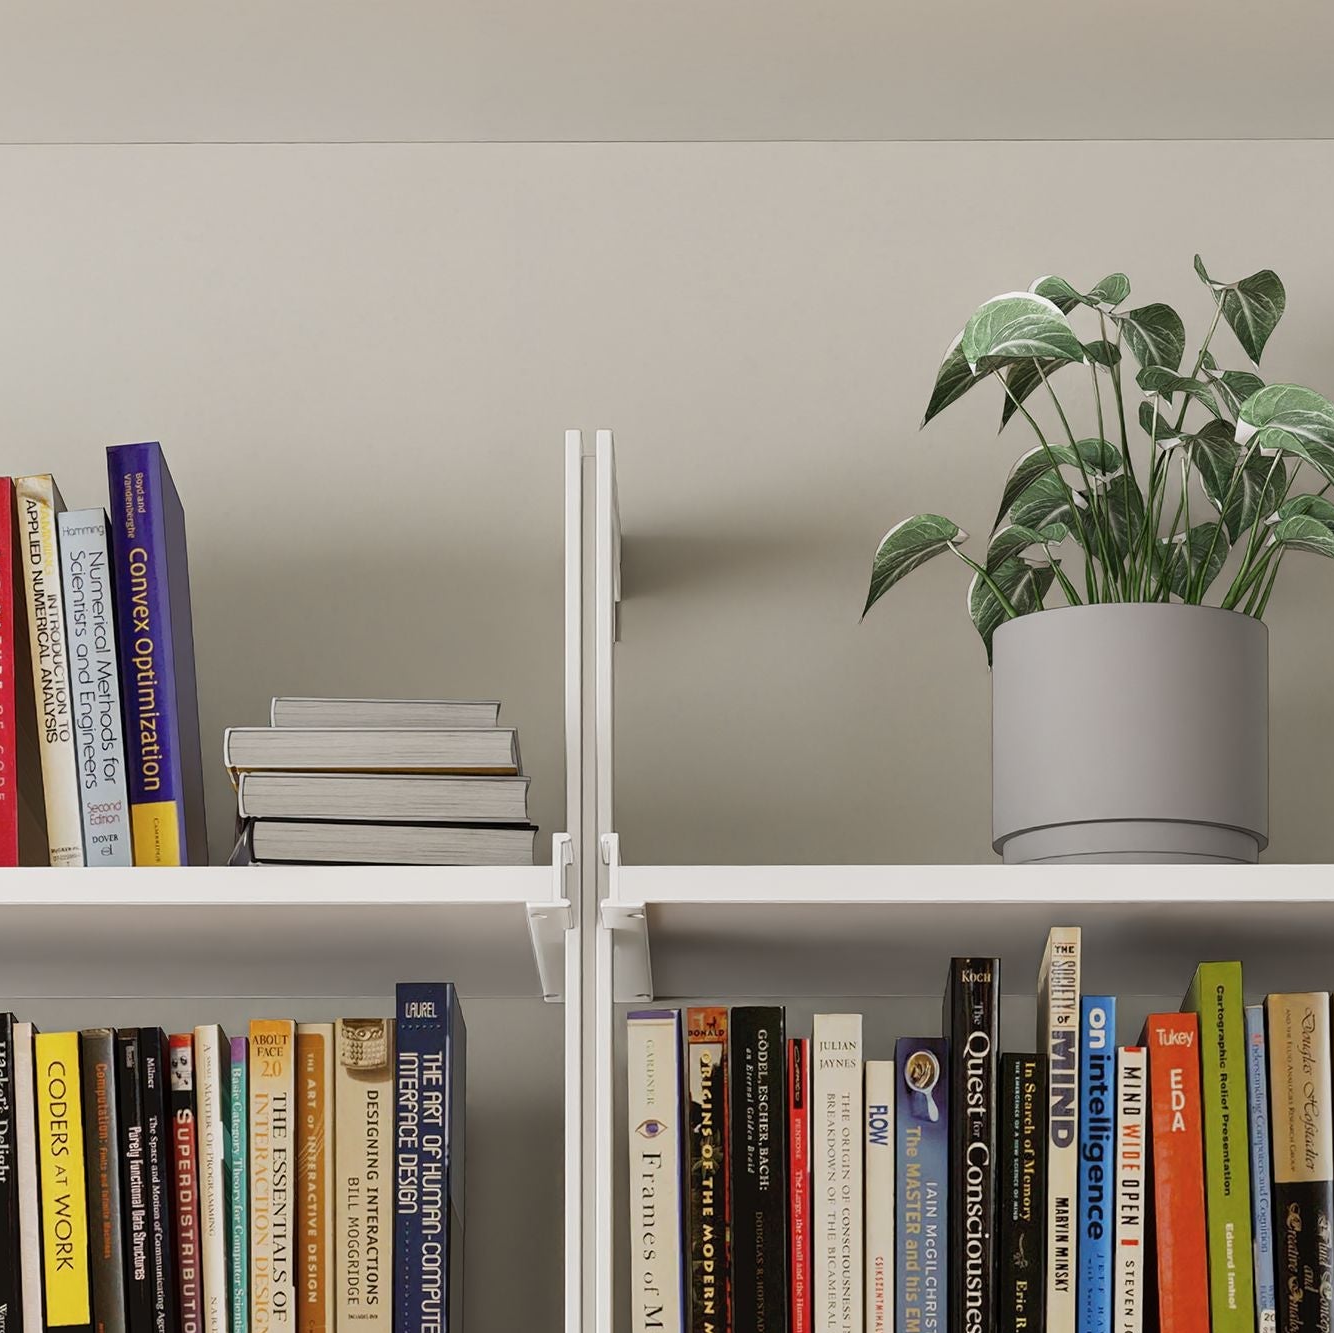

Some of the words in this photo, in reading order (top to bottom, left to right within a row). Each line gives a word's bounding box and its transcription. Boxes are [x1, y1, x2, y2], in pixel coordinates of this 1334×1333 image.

[26, 500, 42, 564] APPLIED
[62, 524, 104, 536] Hamming
[70, 550, 88, 637] Scientists
[88, 551, 111, 653] Numerical
[127, 548, 148, 632] Convex
[32, 570, 50, 664] NUMERICAL
[76, 644, 94, 684] and
[40, 668, 58, 744] ANALYSIS
[97, 660, 117, 750] Methods
[131, 638, 160, 791] Optimization
[77, 693, 98, 789] Engineers
[103, 757, 120, 784] for
[92, 834, 118, 842] DOVER
[406, 1002, 437, 1018] LAUREL
[972, 1002, 984, 1025] The
[1090, 1007, 1106, 1048] on
[252, 1034, 288, 1046] ABOUT
[256, 1047, 284, 1058] FACE
[820, 1040, 858, 1051] JULIAN
[1156, 1028, 1194, 1048] Tukey
[261, 1061, 282, 1078] 2.0
[424, 1051, 443, 1084] THE
[820, 1056, 856, 1068] JAYNES
[964, 1029, 992, 1118] Quest
[47, 1061, 69, 1156] CODERS
[398, 1052, 418, 1146] INTERFACE
[423, 1089, 443, 1127] ART
[699, 1052, 713, 1137] ORIGINS
[1052, 1030, 1076, 1148] MIND
[1123, 1066, 1142, 1116] MIND
[272, 1092, 287, 1138] THE
[367, 1089, 378, 1179] DESIGNING
[868, 1105, 888, 1146] FLOW
[973, 1121, 985, 1139] for
[423, 1135, 442, 1158] OF
[702, 1144, 713, 1175] OF
[905, 1126, 921, 1157] The
[1083, 1054, 1111, 1240] intelligence
[1122, 1122, 1141, 1172] WIDE
[55, 1164, 66, 1186] AT
[254, 1094, 269, 1246] INTERACTION
[348, 1176, 359, 1209] BILL
[398, 1154, 418, 1214] DESIGN
[272, 1146, 288, 1284] ESSENTIALS
[642, 1152, 662, 1259] Frames
[702, 1179, 714, 1217] THE
[906, 1164, 921, 1234] MASTER
[926, 1182, 936, 1218] IAIN
[1121, 1176, 1140, 1226] OPEN
[52, 1194, 74, 1272] WORK
[367, 1185, 379, 1305] INTERACTIONS
[905, 1241, 921, 1262] and
[348, 1215, 360, 1305] MOGGRIDGE
[703, 1224, 715, 1314] MODERN
[905, 1267, 921, 1287] his
[272, 1292, 288, 1322] OF
[644, 1272, 659, 1296] of
[1124, 1260, 1135, 1309] STEVEN
